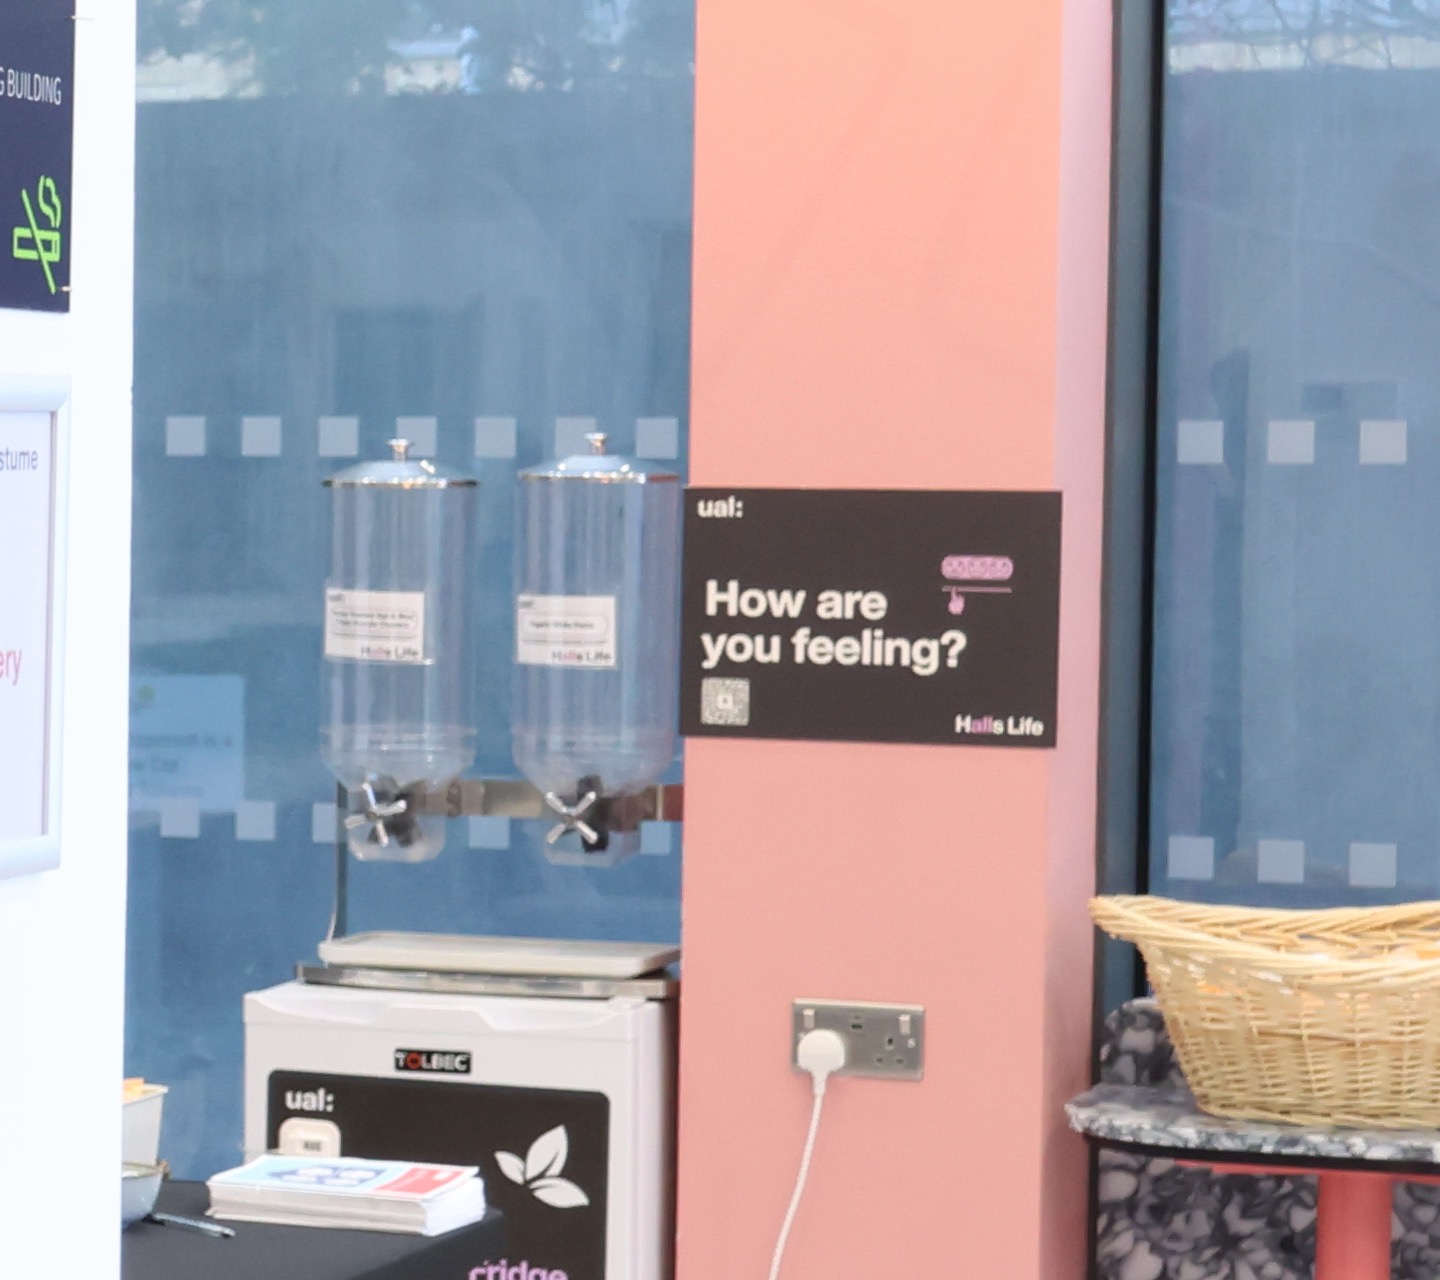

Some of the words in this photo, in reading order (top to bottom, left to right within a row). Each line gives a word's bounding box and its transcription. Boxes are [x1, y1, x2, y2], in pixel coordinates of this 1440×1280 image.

[7, 68, 62, 106] BUILDING
[697, 496, 744, 519] ual:
[705, 578, 807, 618] How
[816, 588, 888, 620] are
[699, 631, 781, 670] you
[791, 626, 968, 676] feeling?
[954, 715, 1004, 736] Halls
[1007, 716, 1045, 737] Life
[285, 1087, 334, 1112] ual:
